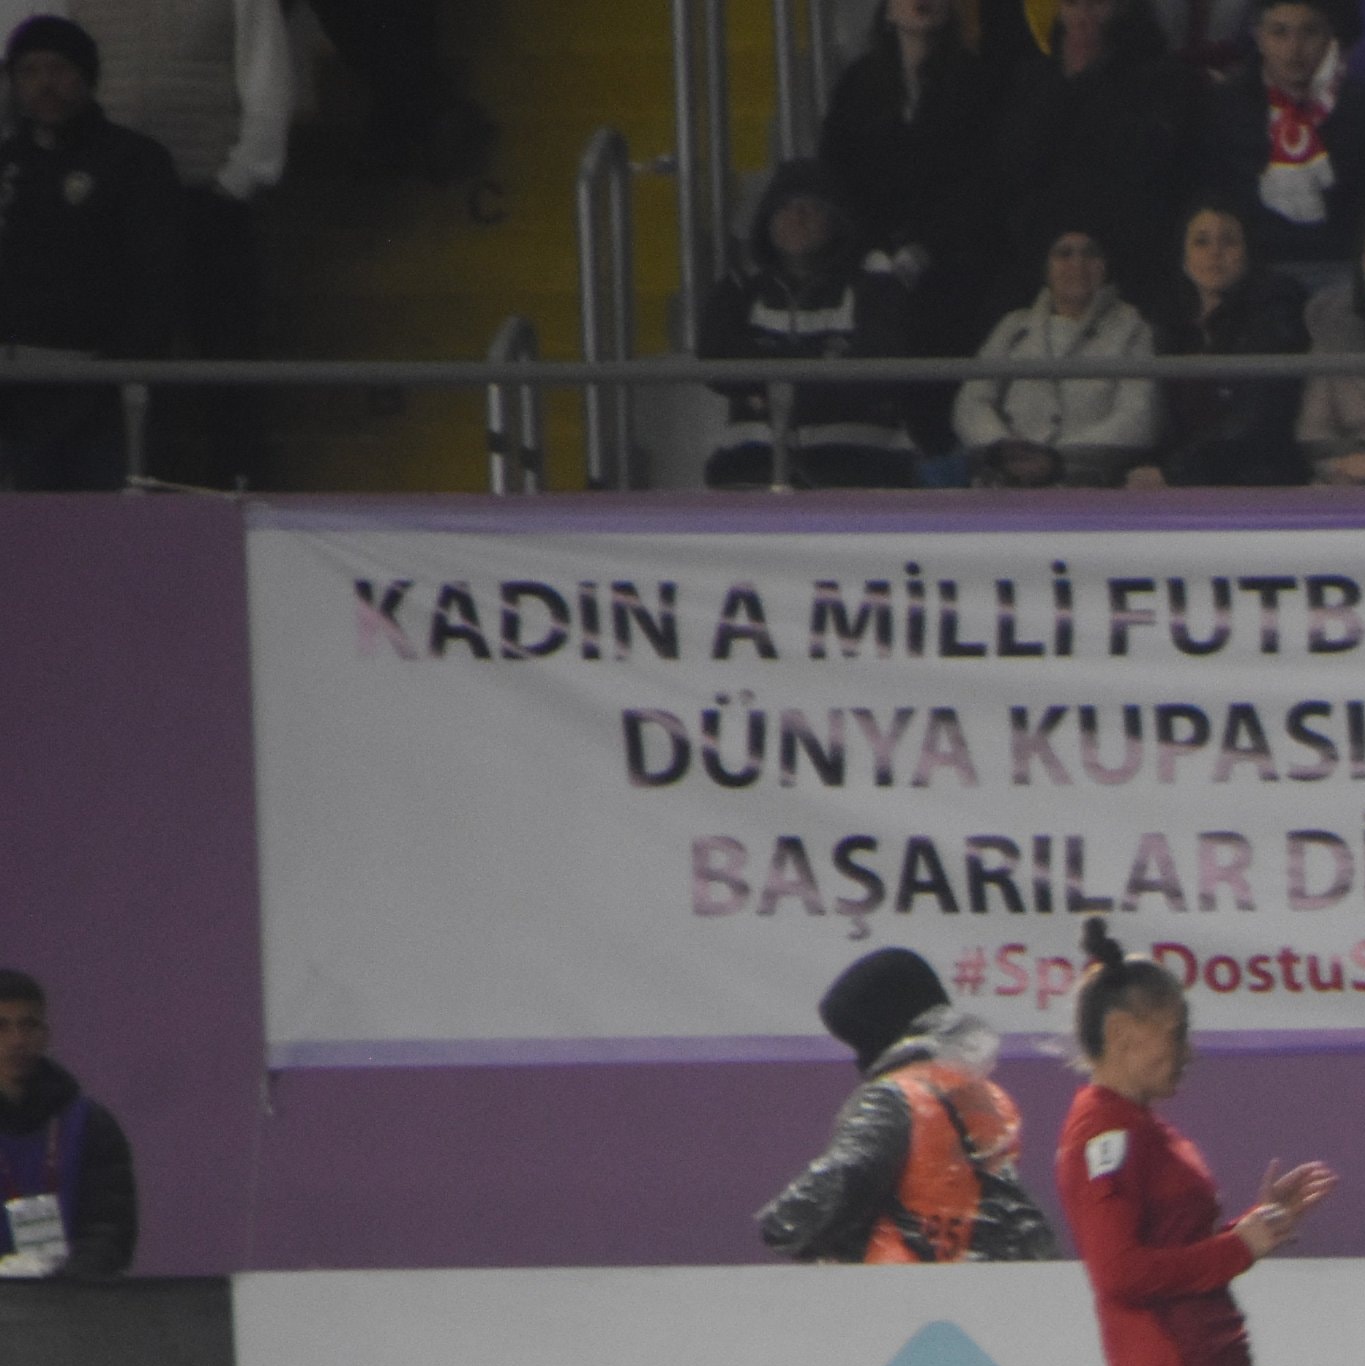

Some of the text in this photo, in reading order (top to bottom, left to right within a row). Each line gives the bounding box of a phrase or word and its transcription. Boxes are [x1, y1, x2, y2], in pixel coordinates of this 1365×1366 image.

[354, 577, 680, 662] KADIN
[711, 580, 778, 661] A
[808, 561, 1075, 660] MİLLİ
[621, 690, 978, 790] DÜNYA
[690, 829, 1257, 941] BAŞARILAR
